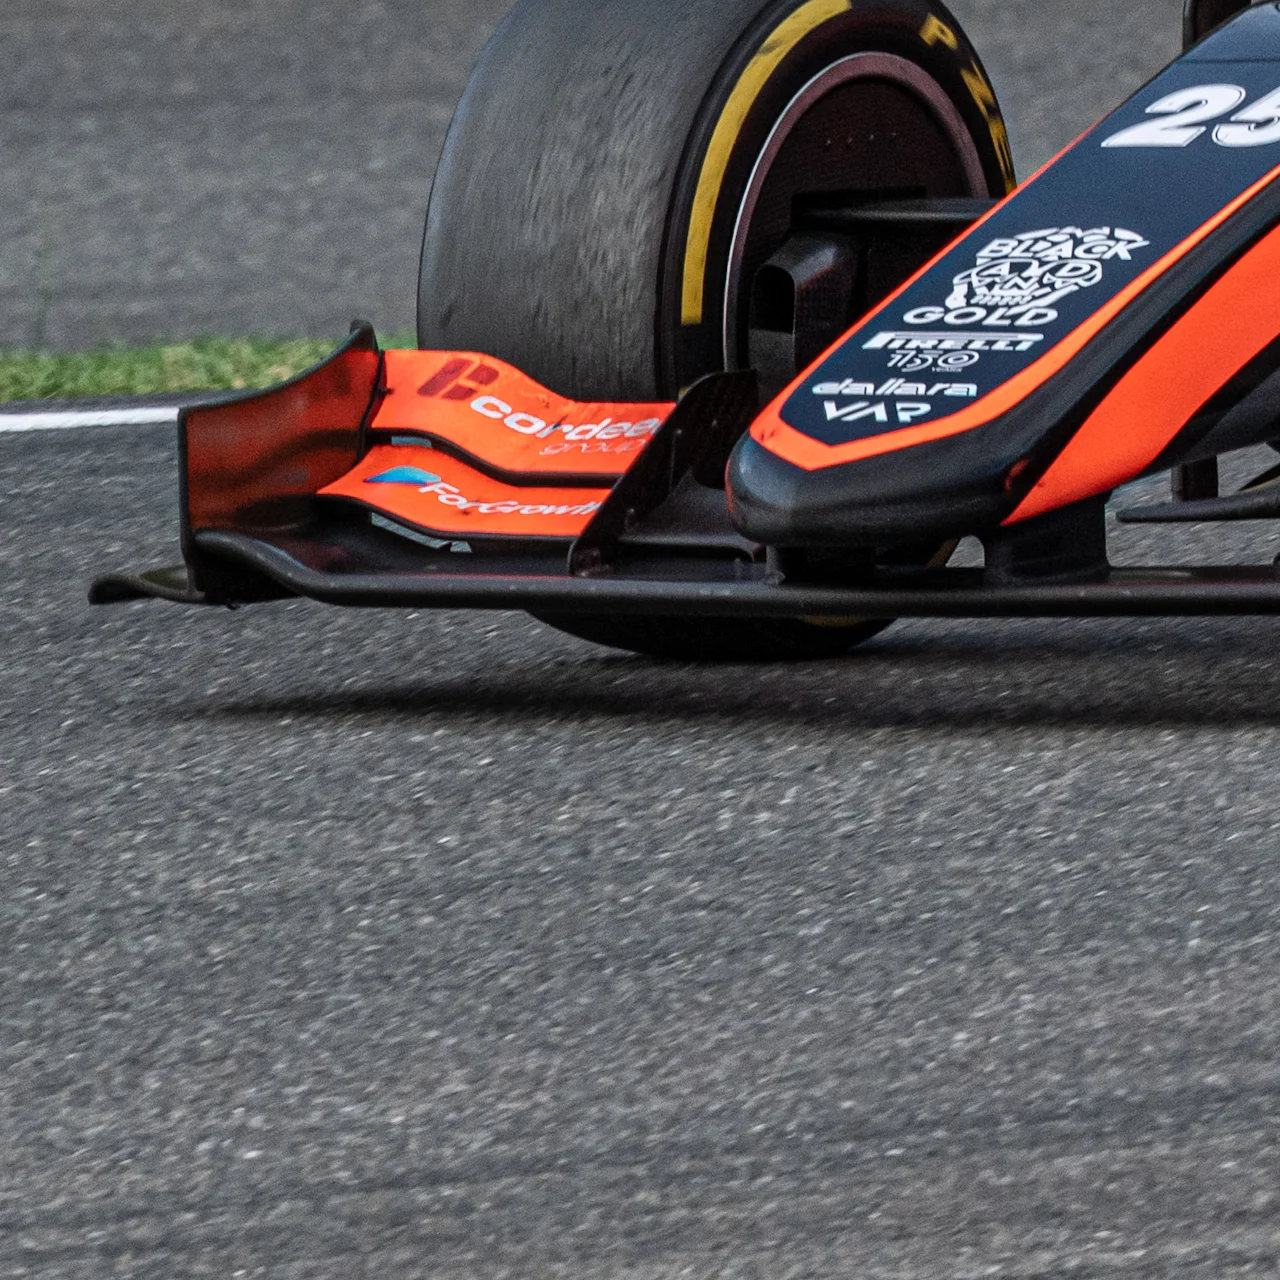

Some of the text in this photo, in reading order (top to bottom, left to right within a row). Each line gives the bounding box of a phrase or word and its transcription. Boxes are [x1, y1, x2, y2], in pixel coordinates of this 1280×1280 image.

[976, 238, 1150, 261] BLACK
[903, 306, 1058, 327] GOLD
[862, 331, 1044, 352] PIRELLI
[812, 377, 978, 397] dallara
[823, 400, 931, 423] VAR
